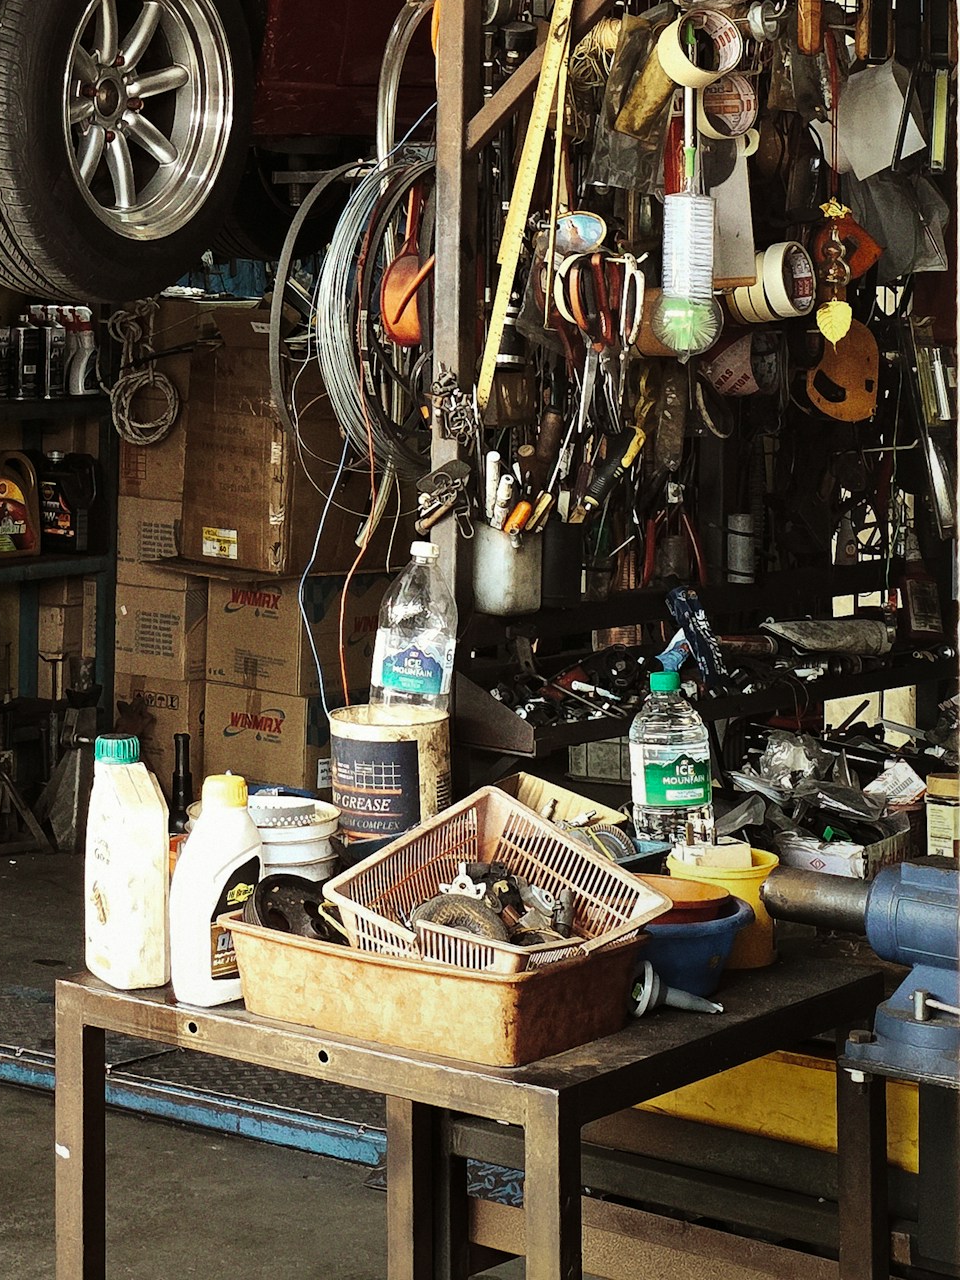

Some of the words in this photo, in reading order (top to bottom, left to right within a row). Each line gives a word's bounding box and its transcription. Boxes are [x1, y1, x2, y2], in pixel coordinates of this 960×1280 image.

[231, 588, 282, 610] WINMAX
[404, 657, 422, 669] ICE
[392, 665, 433, 678] MOUNTAIN
[230, 711, 284, 735] WINMAX
[675, 764, 695, 776] ICE
[662, 774, 705, 785] MOUNTAIN
[341, 794, 392, 812] GREASE
[360, 819, 401, 831] COMPLEX
